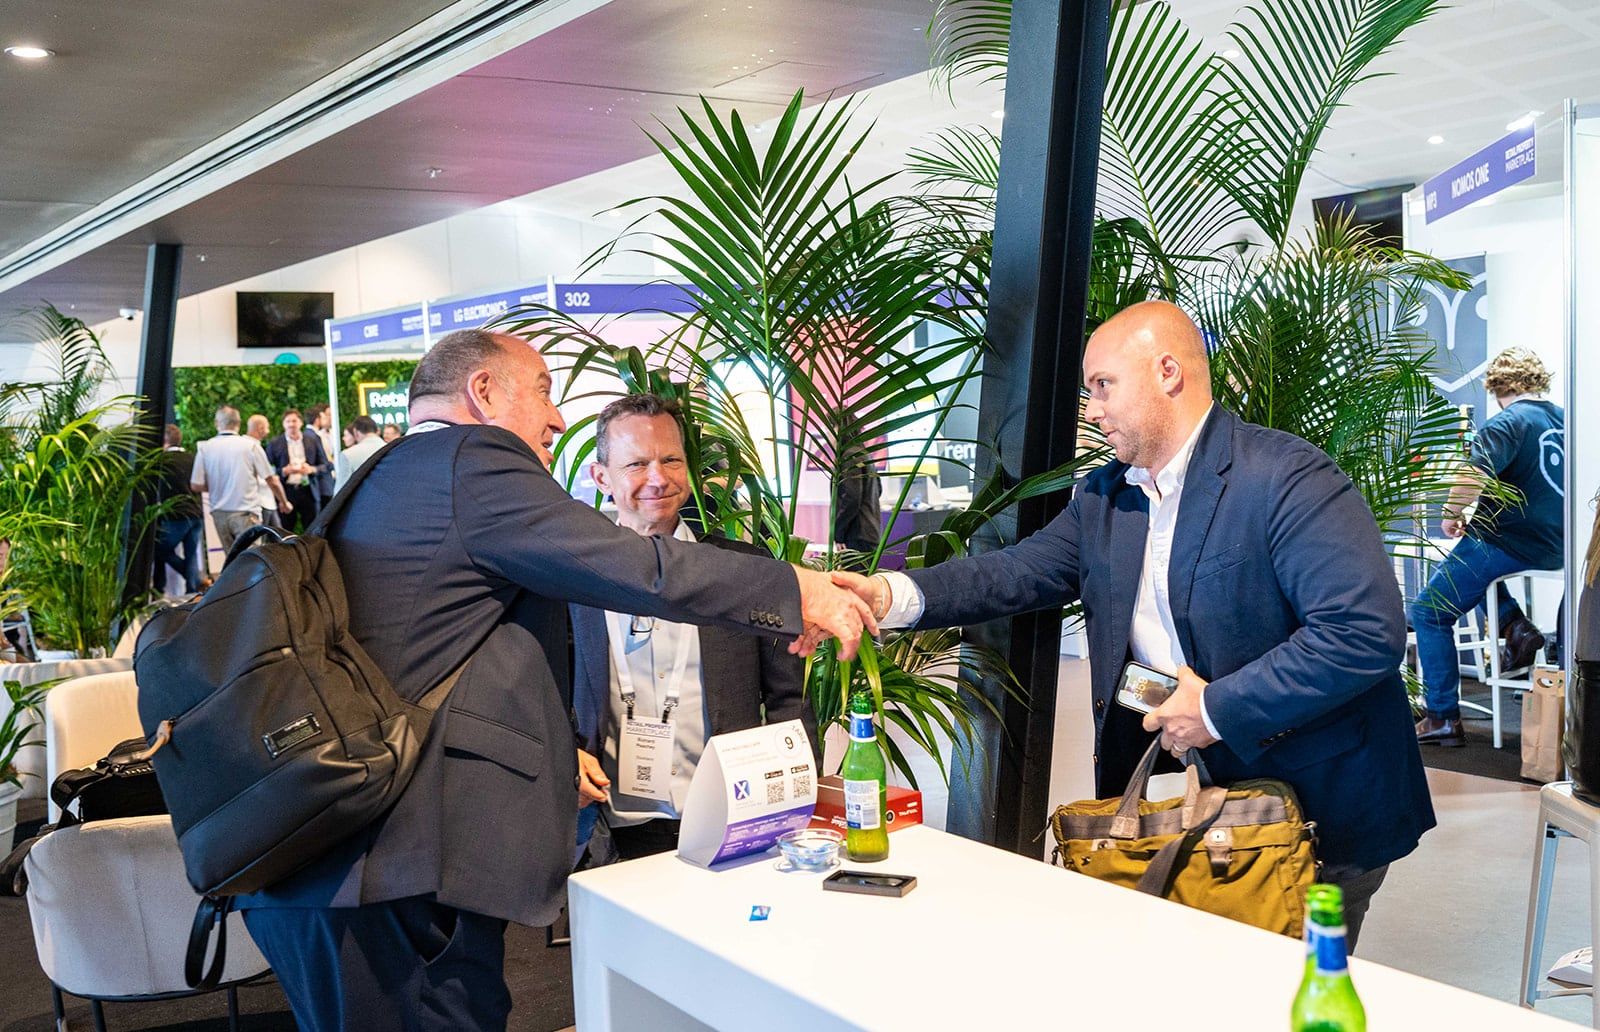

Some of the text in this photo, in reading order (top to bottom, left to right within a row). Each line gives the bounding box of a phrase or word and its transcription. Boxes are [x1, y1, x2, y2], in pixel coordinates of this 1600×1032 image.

[1504, 149, 1535, 173] MARKETPLACE
[1451, 162, 1490, 199] NOMOS ONE
[564, 291, 591, 308] 302
[453, 308, 464, 323] LG
[463, 300, 507, 320] ELECTRONICS
[369, 388, 410, 408] Retai
[371, 411, 410, 425] MAR
[626, 727, 672, 736] MARKETPLACE
[644, 722, 672, 730] PROPERTY
[784, 736, 794, 749] 9
